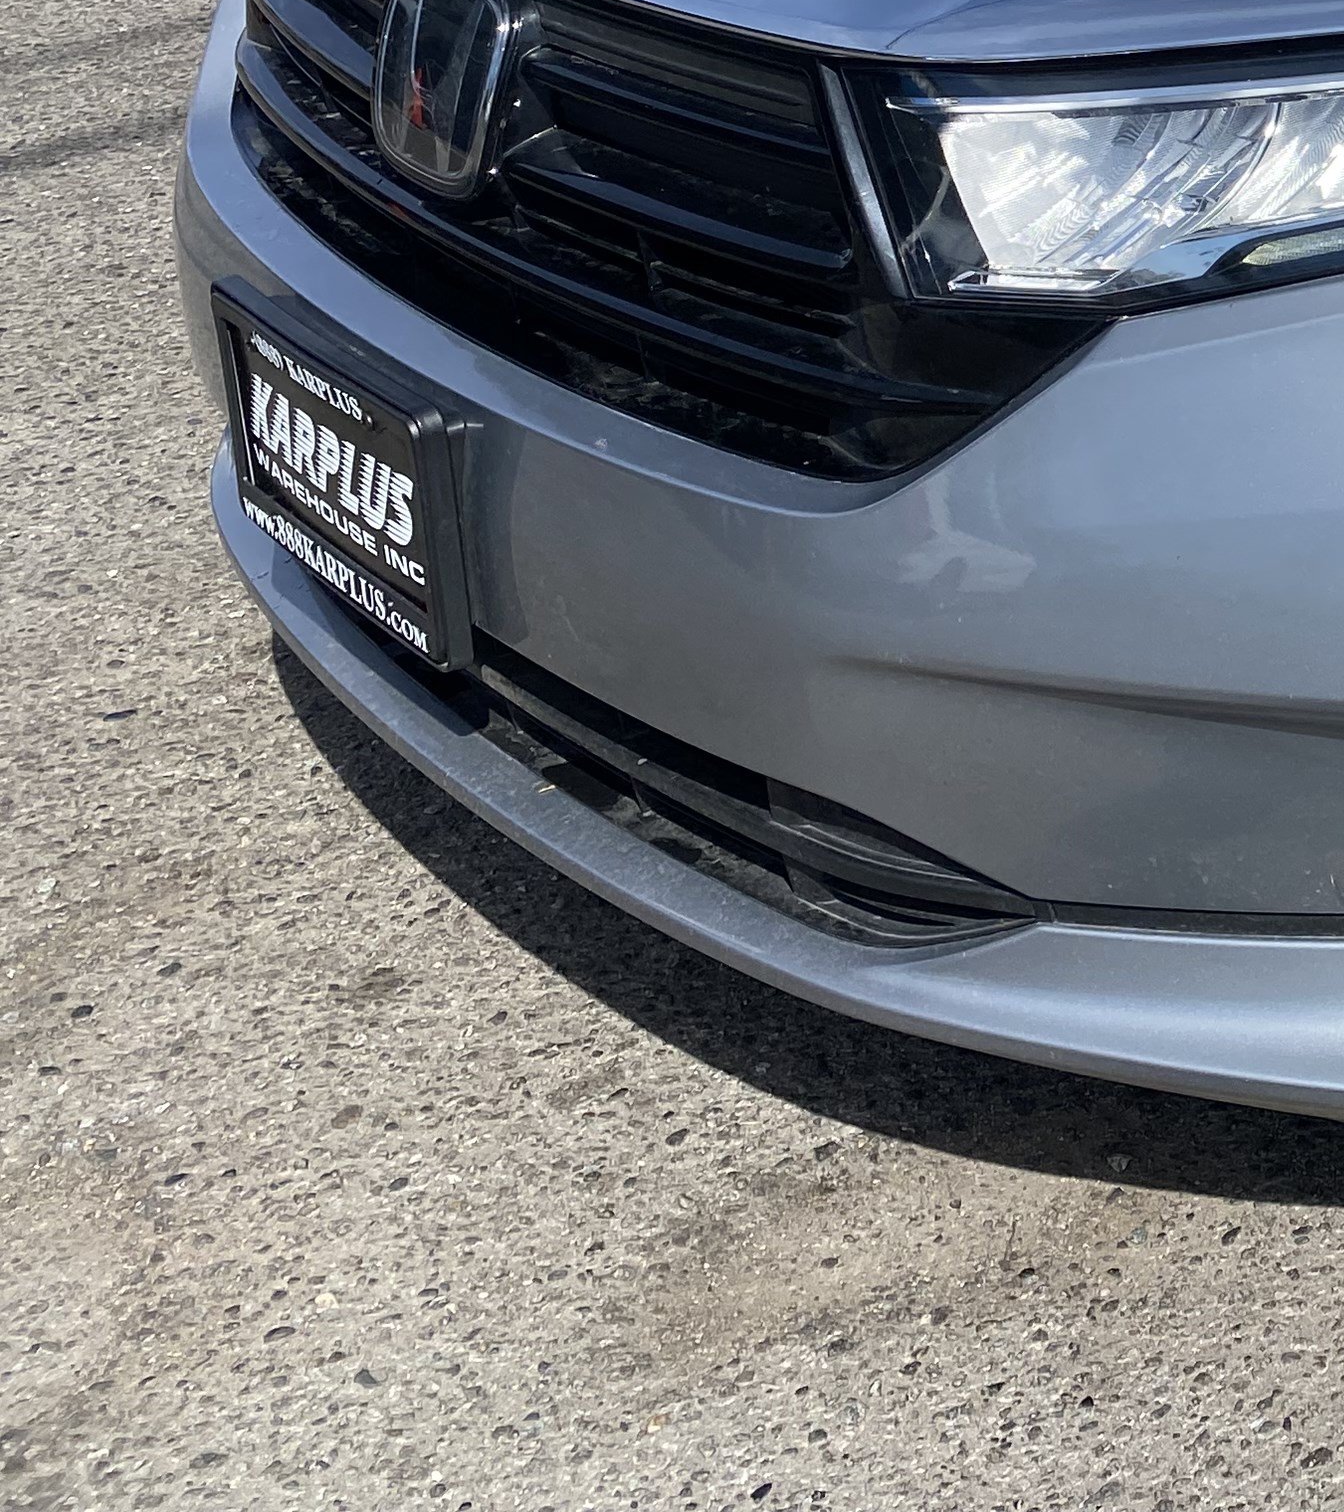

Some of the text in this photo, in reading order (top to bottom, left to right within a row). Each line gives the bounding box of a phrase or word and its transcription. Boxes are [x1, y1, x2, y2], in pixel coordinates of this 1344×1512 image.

[250, 372, 414, 547] KARPLUS
[283, 354, 363, 423] KARPLUS
[253, 443, 425, 586] WAREHOUSE INC
